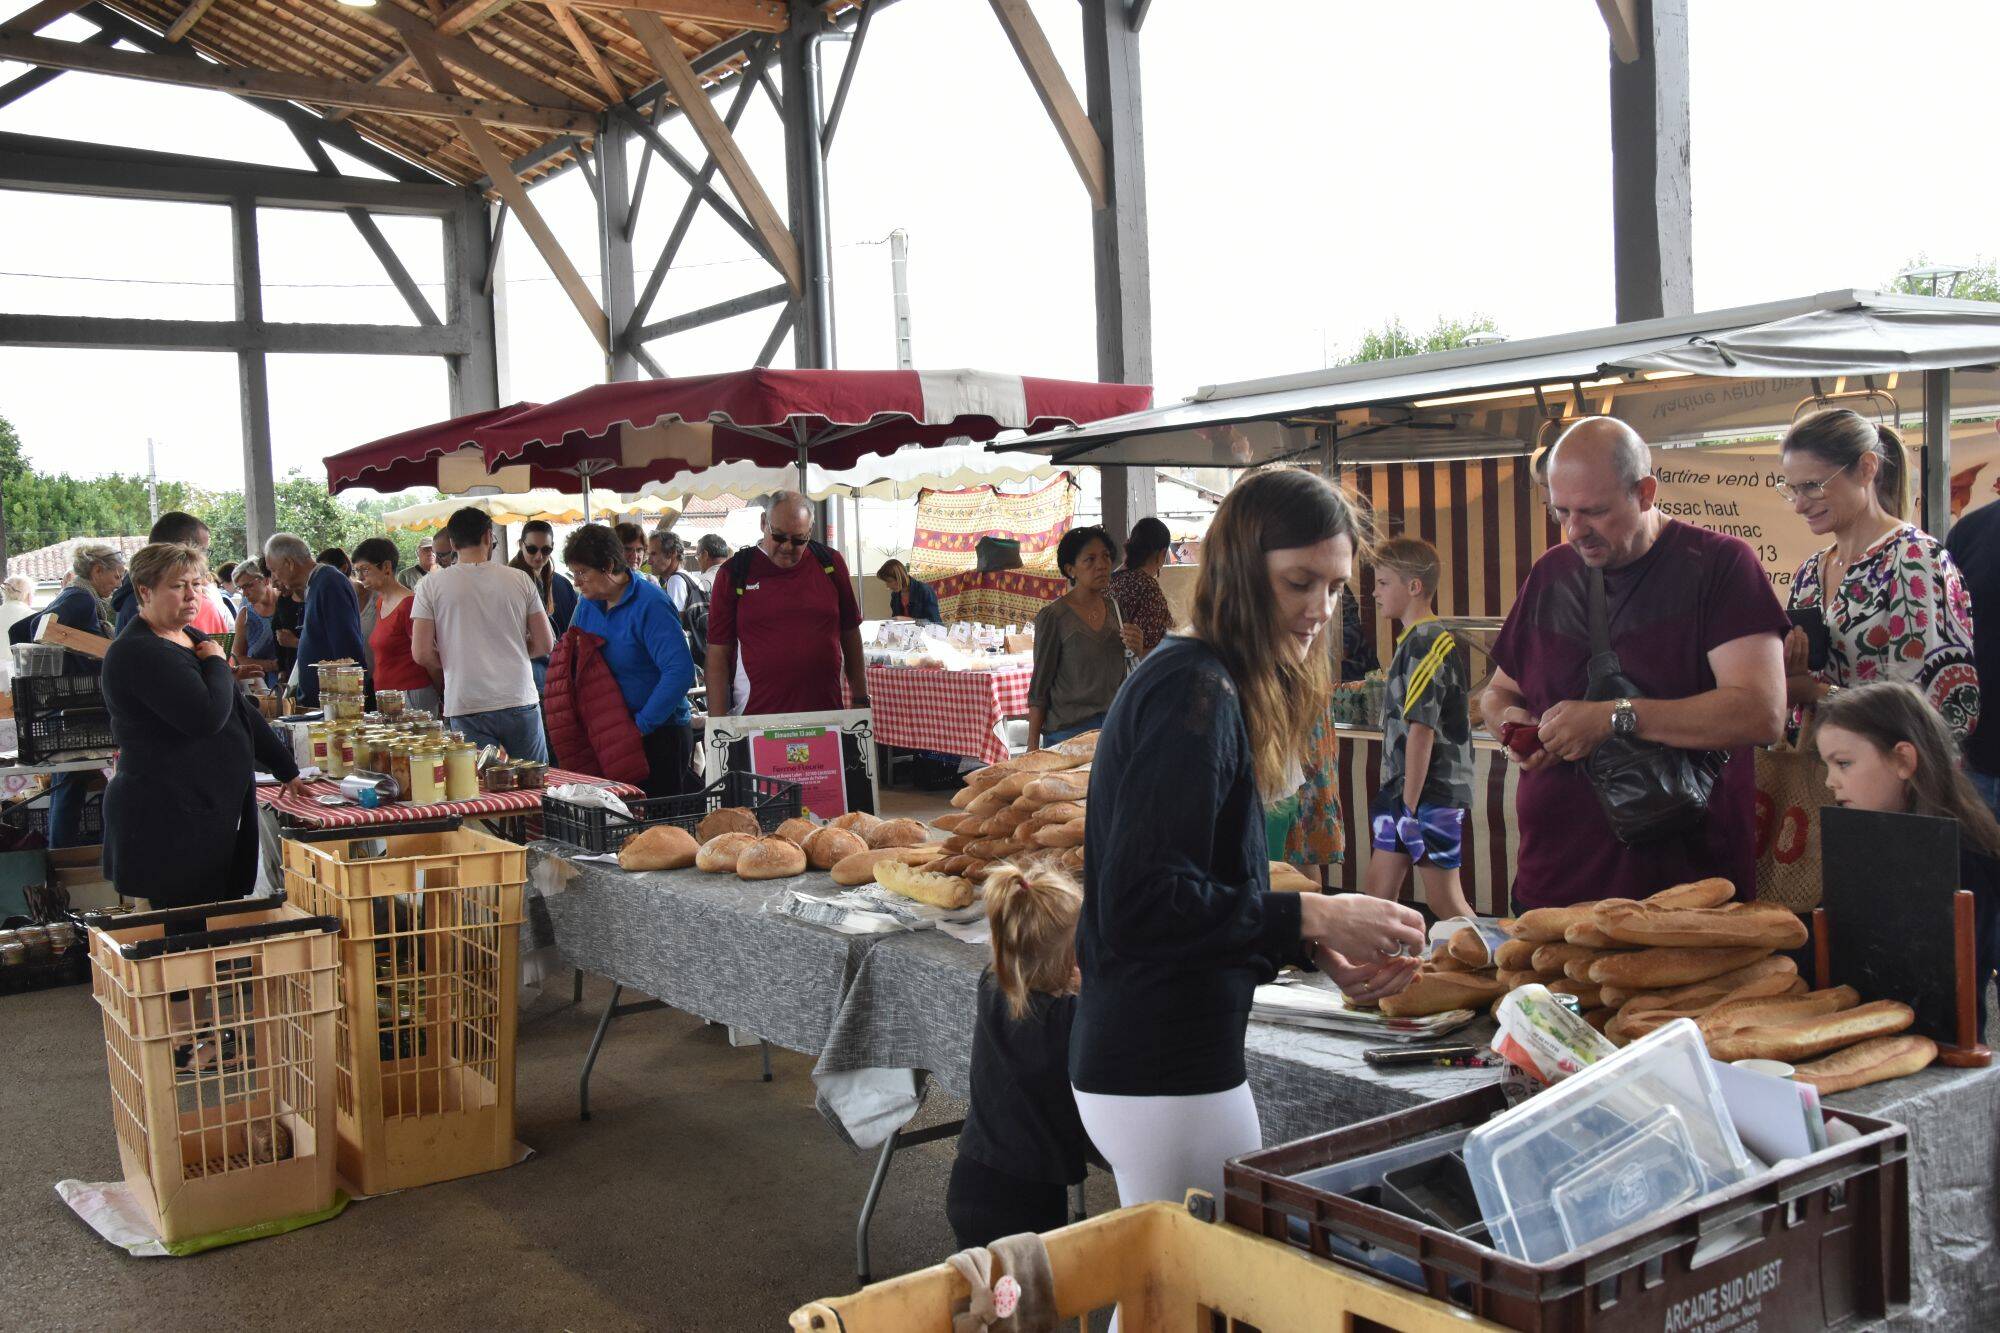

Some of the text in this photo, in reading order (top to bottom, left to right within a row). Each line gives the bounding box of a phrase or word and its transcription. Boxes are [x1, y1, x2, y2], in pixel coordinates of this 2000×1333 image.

[1651, 467, 1786, 487] Martine vend de
[1704, 500, 1740, 516] haut
[774, 731, 798, 739] Dimanche
[1664, 1259, 1783, 1333] ARCADIE SUD OUEST
